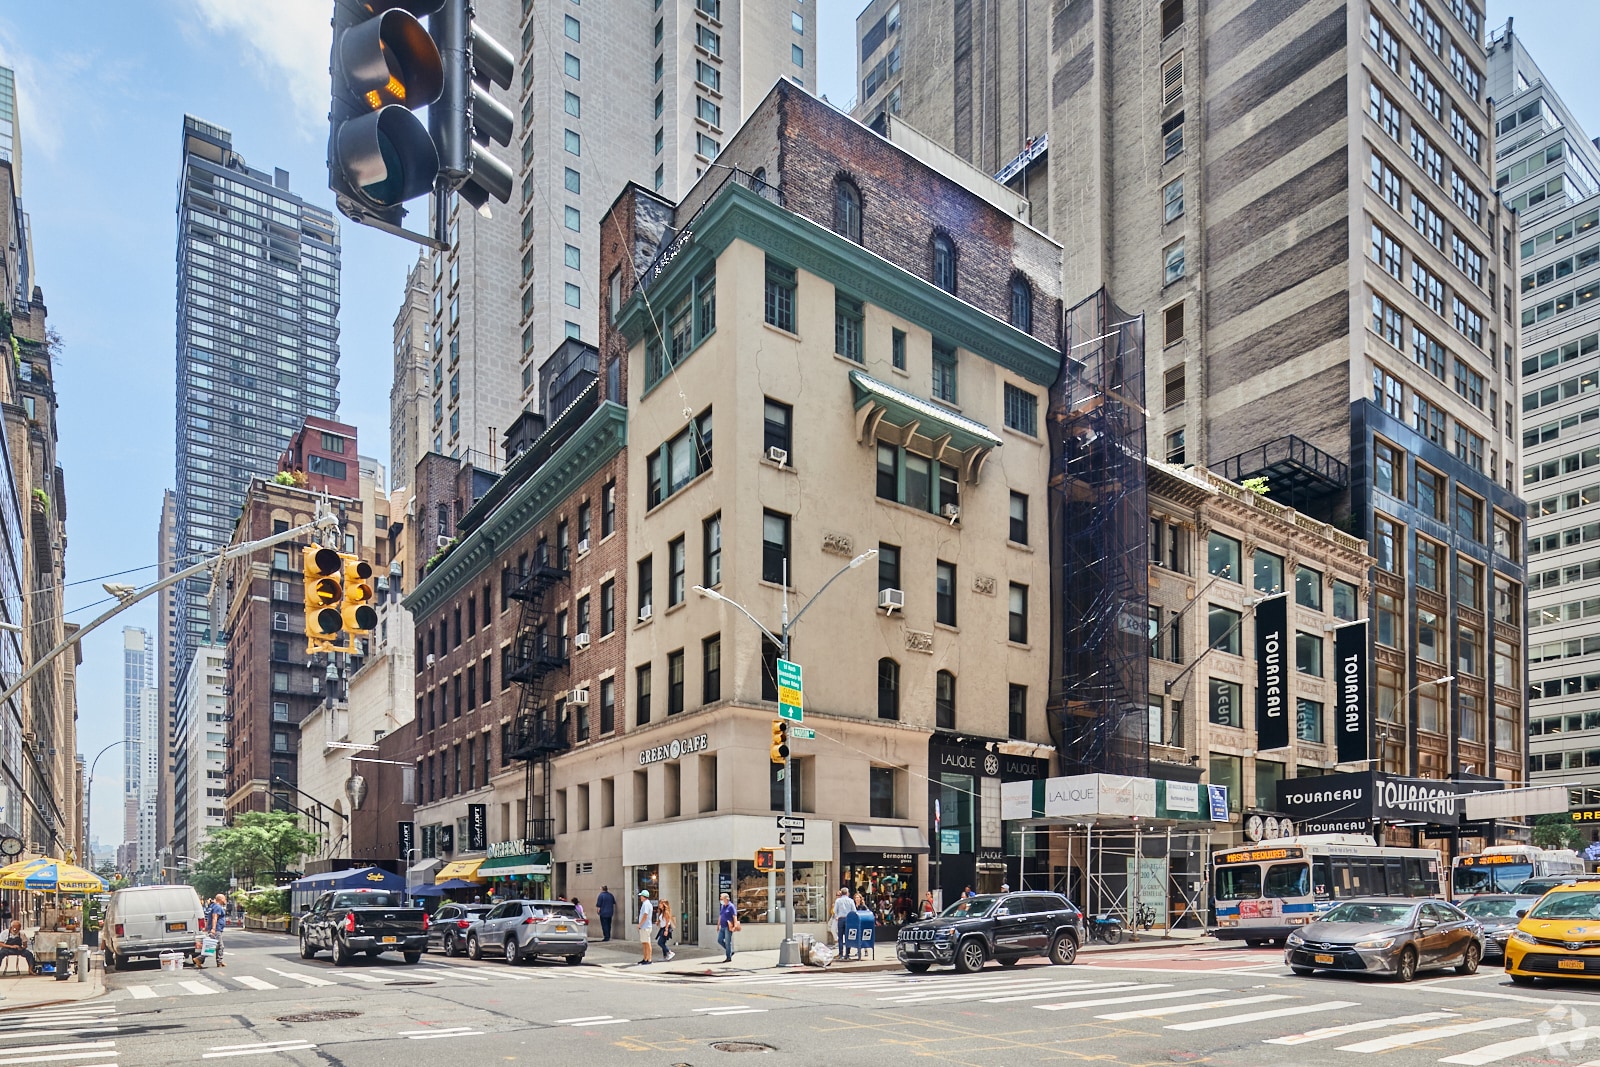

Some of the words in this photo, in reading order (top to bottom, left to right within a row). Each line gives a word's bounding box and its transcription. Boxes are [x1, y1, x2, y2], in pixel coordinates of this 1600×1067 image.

[1265, 631, 1281, 718] TOURNEAU
[1344, 654, 1359, 733] TOURNEAU
[639, 744, 670, 765] GREEN
[680, 734, 708, 754] CAFE
[941, 753, 976, 769] LALIQUE
[1006, 761, 1038, 775] LALIQUE
[1049, 788, 1094, 802] LALIQUE
[1285, 788, 1362, 805] TOURNEAU
[1376, 780, 1455, 816] TOURNEAU
[1307, 821, 1366, 833] TOURNEAU
[882, 852, 912, 860] Sermoneta
[980, 851, 1003, 860] LALIQUE
[1226, 852, 1250, 862] MASKS
[1251, 849, 1287, 860] REQUIRED
